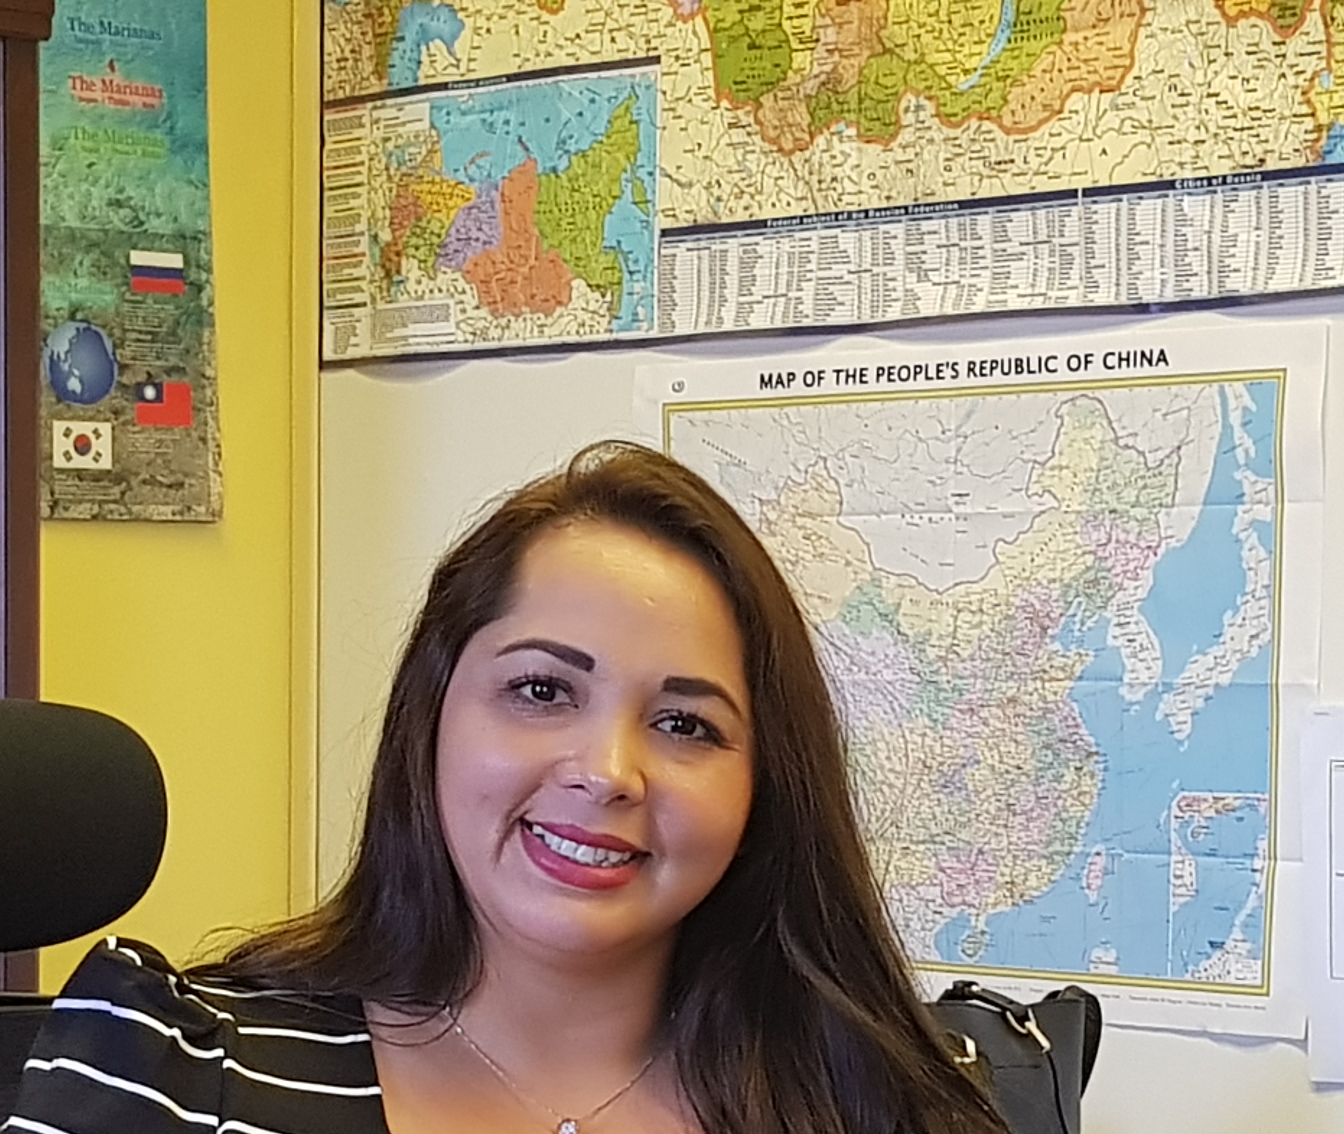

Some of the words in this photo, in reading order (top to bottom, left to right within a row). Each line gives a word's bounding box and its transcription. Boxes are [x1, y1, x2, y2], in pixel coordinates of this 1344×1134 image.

[66, 16, 96, 34] The
[98, 20, 162, 42] Marianas
[68, 75, 96, 92] The
[100, 78, 163, 100] Marianas
[73, 125, 99, 143] The
[103, 128, 166, 149] Marianas
[758, 372, 797, 390] MAP
[803, 369, 827, 388] OF
[832, 367, 869, 386] THE
[875, 362, 960, 383] PEOPLE'S
[966, 355, 1059, 378] REPUBLIC
[1066, 353, 1094, 372] OF
[1102, 348, 1170, 370] CHINA
